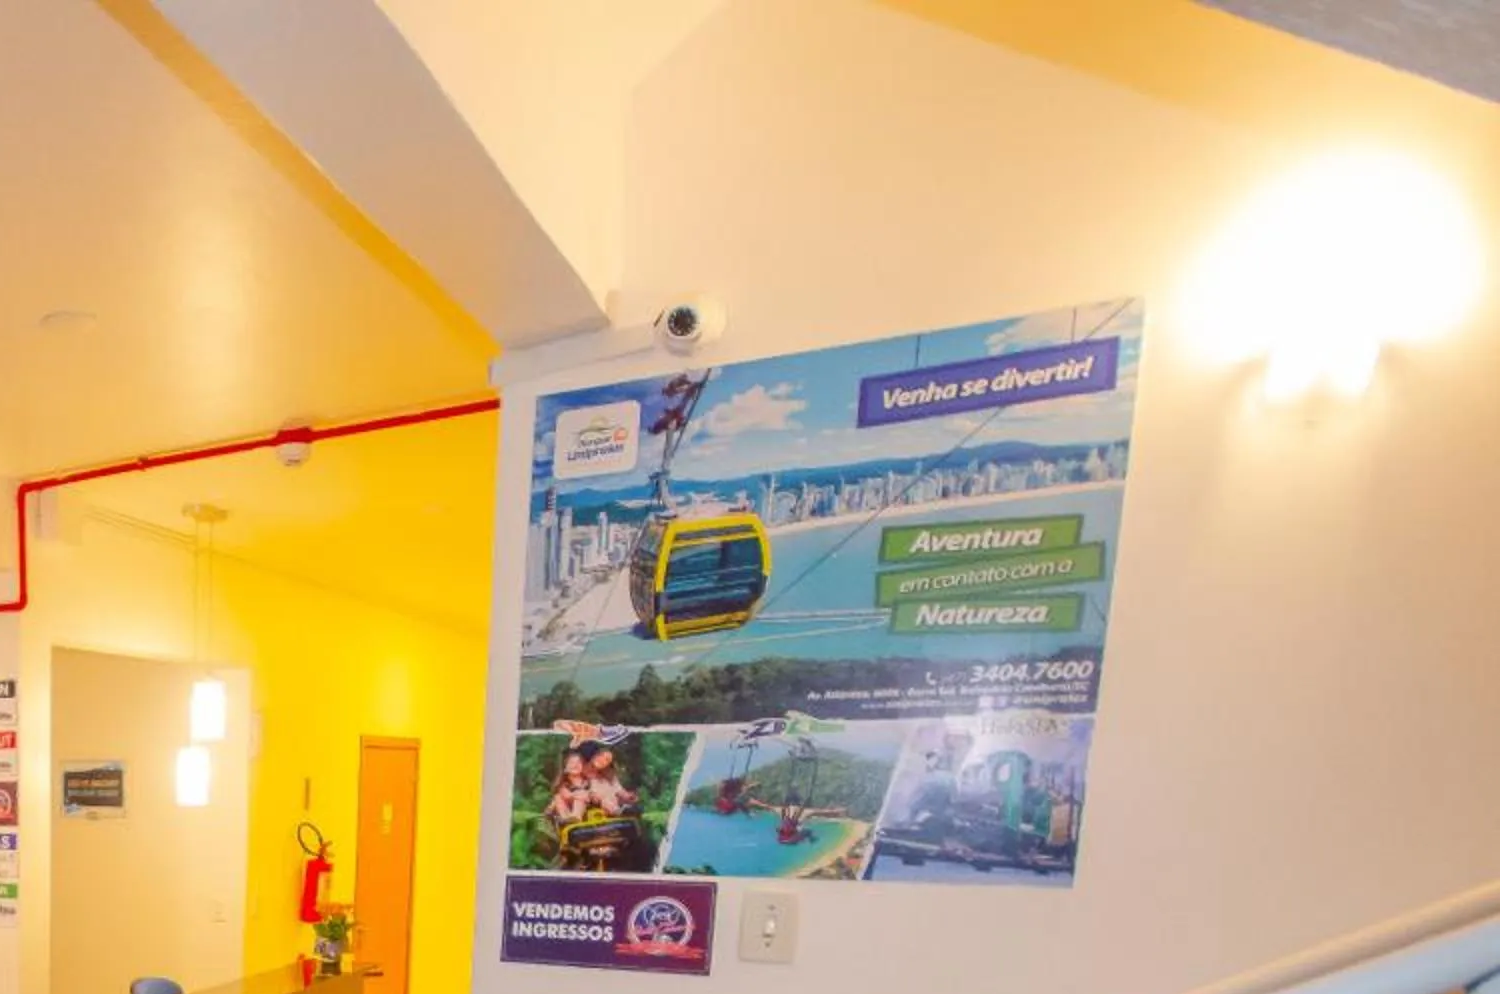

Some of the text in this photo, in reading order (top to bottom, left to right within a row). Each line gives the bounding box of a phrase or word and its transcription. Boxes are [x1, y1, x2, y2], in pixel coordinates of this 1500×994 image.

[883, 356, 1095, 409] Venha se divertir!
[909, 526, 1045, 553] Aventura
[899, 558, 1074, 593] em contato com a
[915, 603, 1049, 627] Natureza
[969, 660, 1095, 684] 3404.7600
[512, 901, 616, 923] VENDEMOS
[511, 921, 614, 943] INGRESSOS
